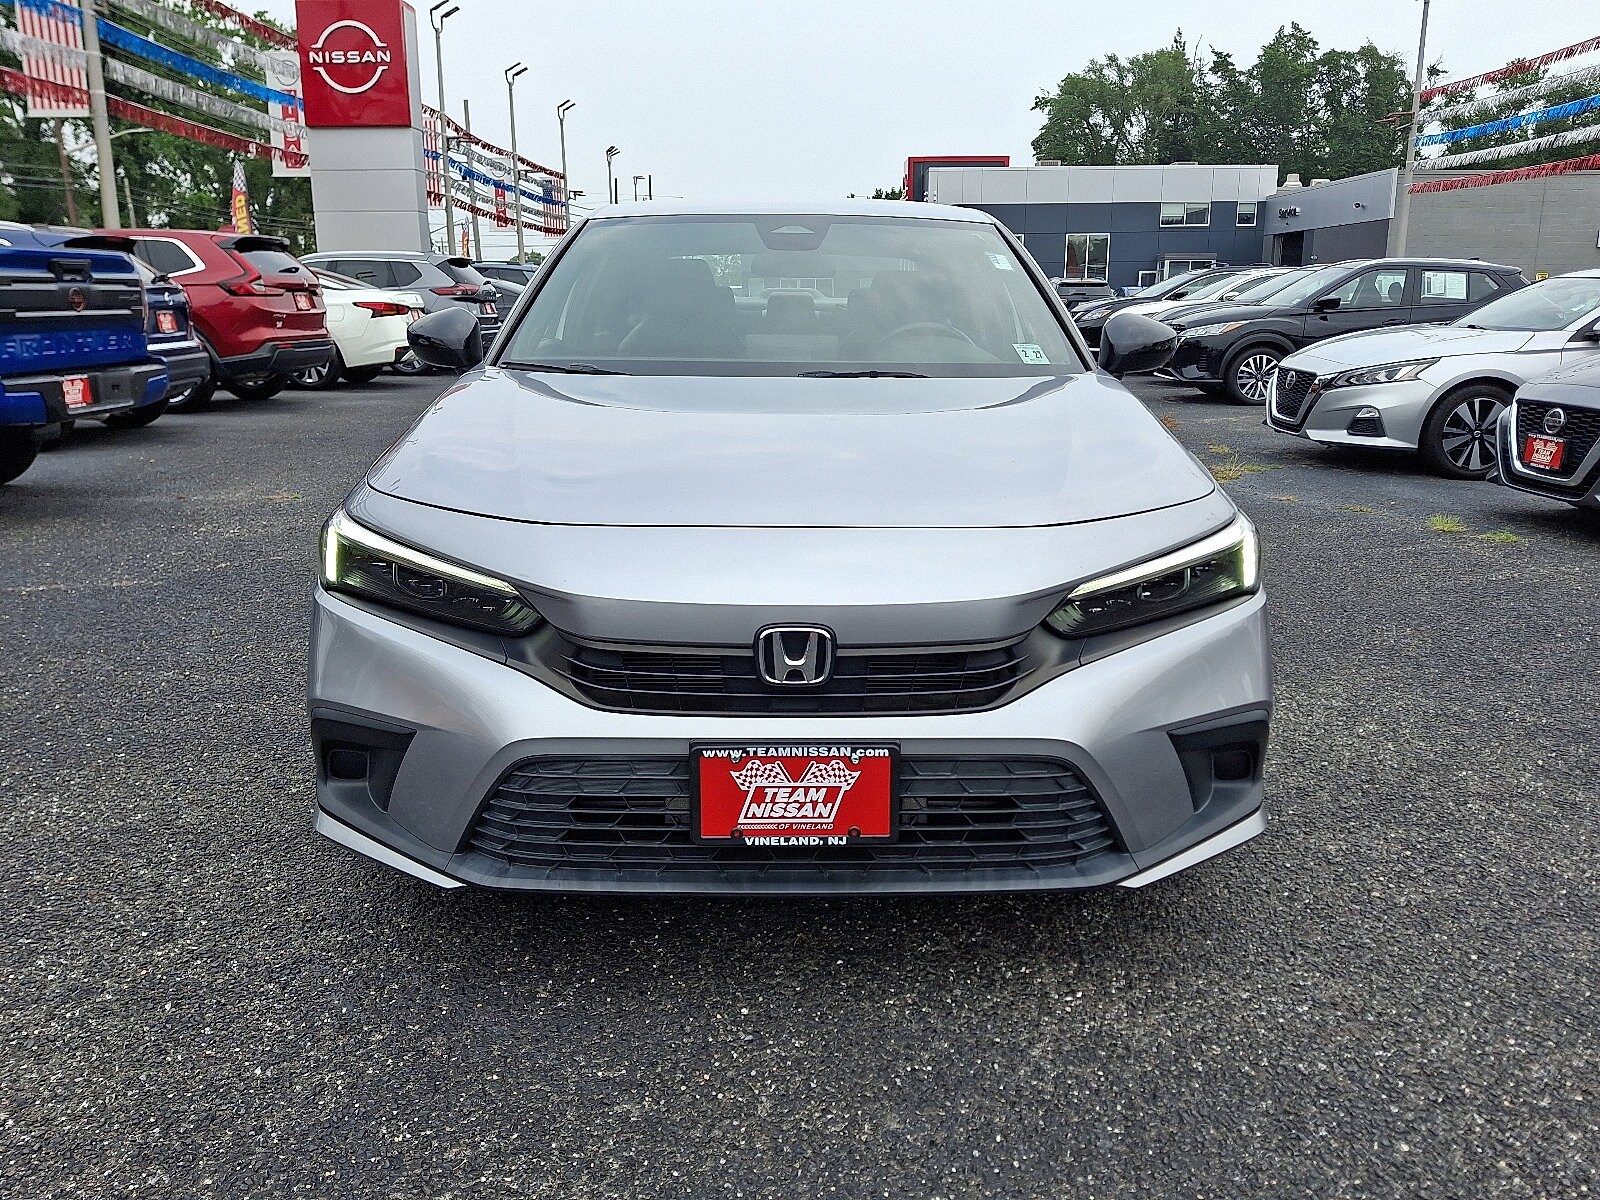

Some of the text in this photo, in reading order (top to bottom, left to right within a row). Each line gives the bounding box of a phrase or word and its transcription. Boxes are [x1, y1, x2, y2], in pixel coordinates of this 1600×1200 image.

[308, 49, 391, 64] NISSAN
[1022, 349, 1043, 359] 2 27
[702, 747, 890, 758] www.TEAMNISSAN.com
[764, 787, 828, 803] TEAM
[746, 803, 833, 818] NISSAN
[744, 836, 847, 846] VINELAND, NJ
